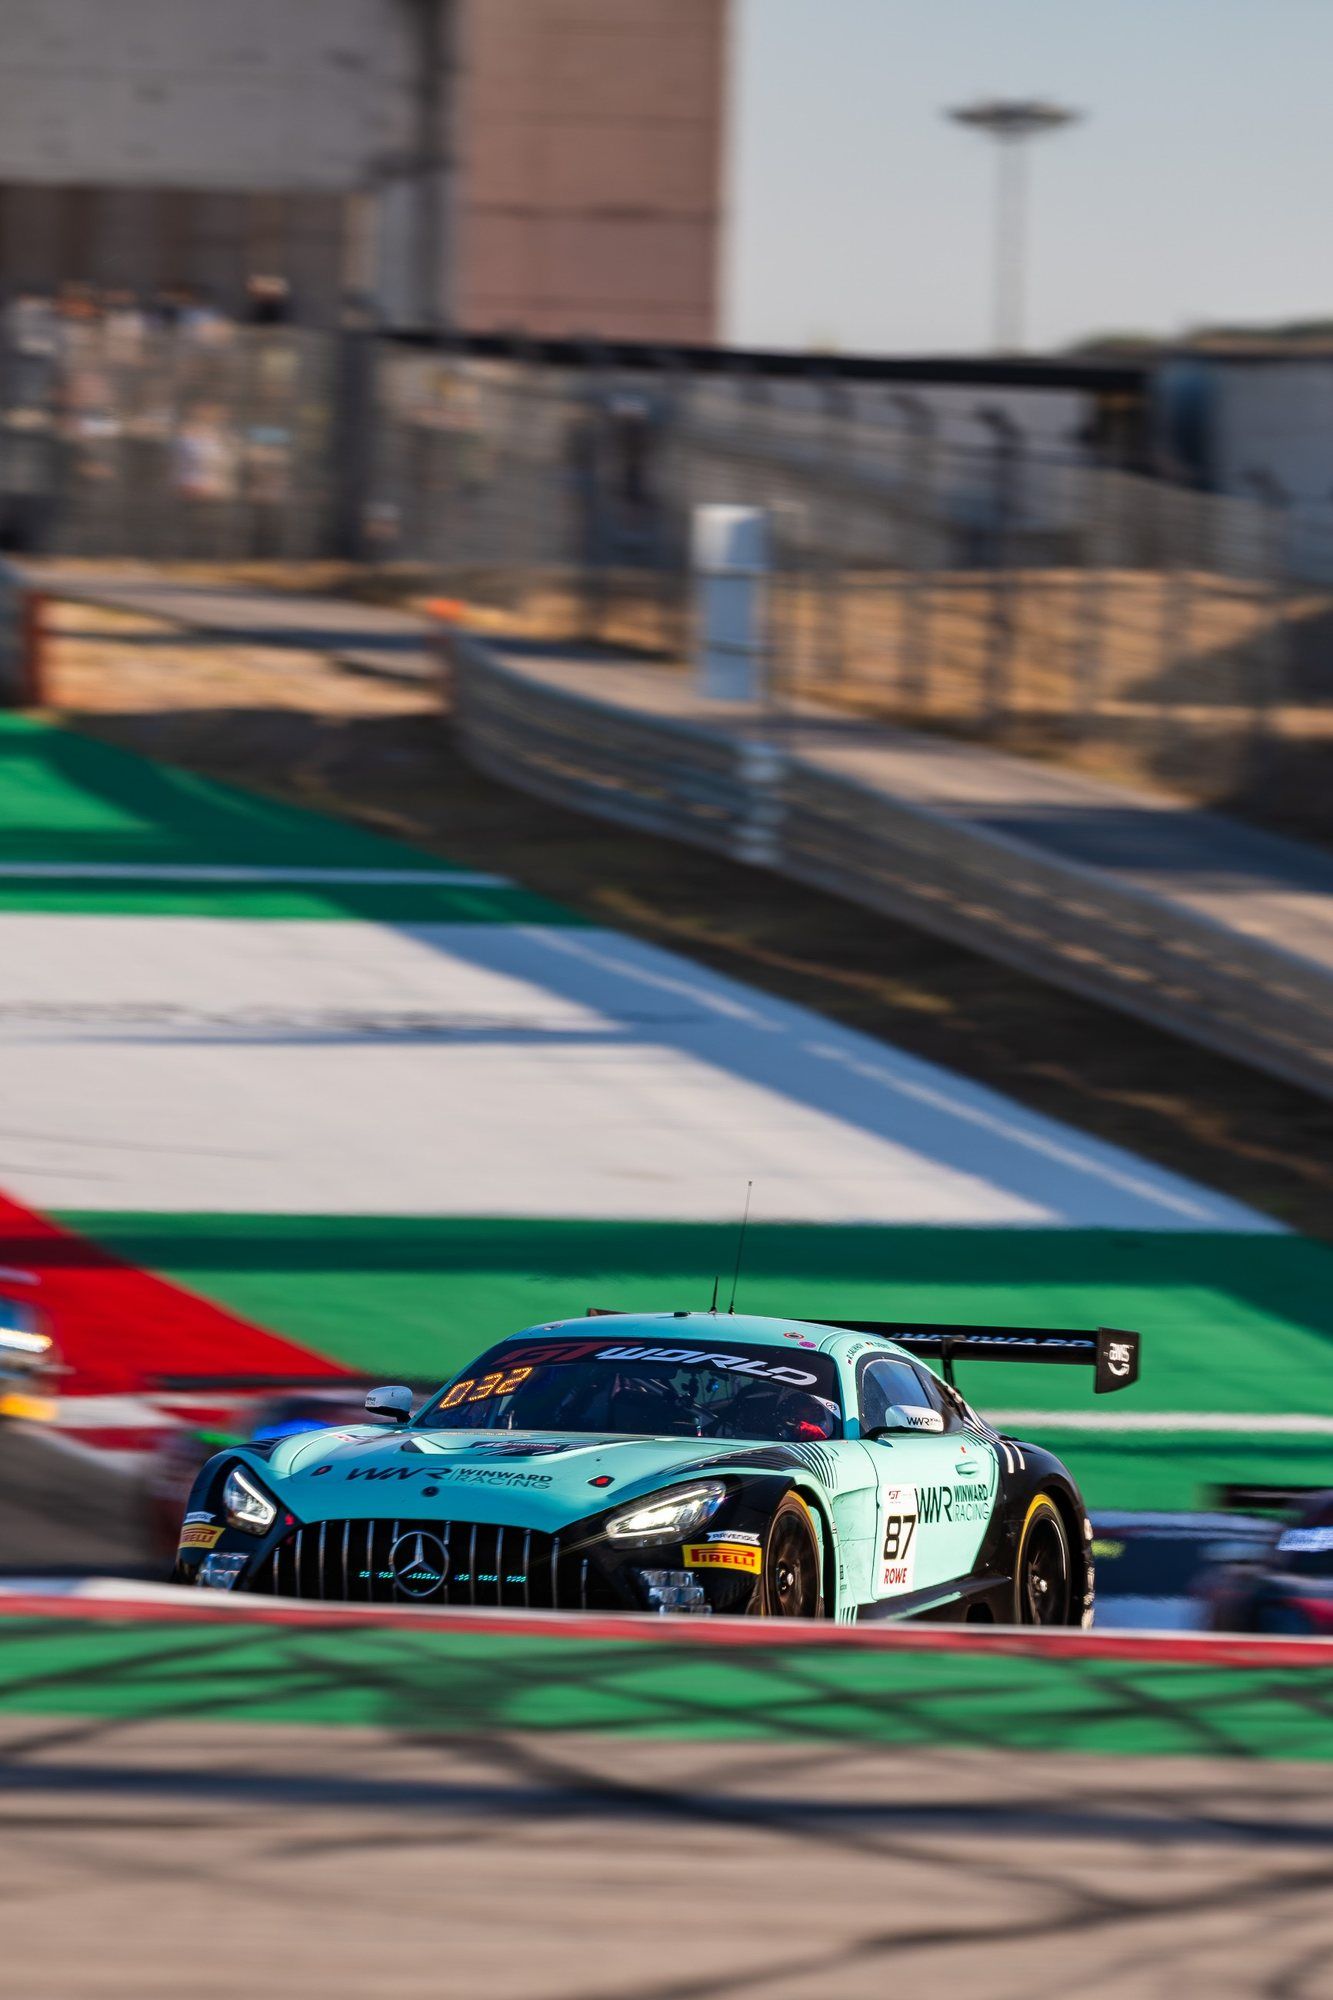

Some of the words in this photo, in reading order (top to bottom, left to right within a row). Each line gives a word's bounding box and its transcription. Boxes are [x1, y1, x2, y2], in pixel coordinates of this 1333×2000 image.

[595, 1347, 818, 1386] WORLD
[440, 1367, 533, 1408] 032
[454, 1474, 551, 1490] RACING
[459, 1468, 553, 1482] WINWARD
[953, 1483, 989, 1503] WINWARD
[954, 1502, 990, 1522] RACING
[883, 1514, 917, 1560] 87
[690, 1548, 755, 1567] PIRELLI
[883, 1567, 908, 1584] ROWE
